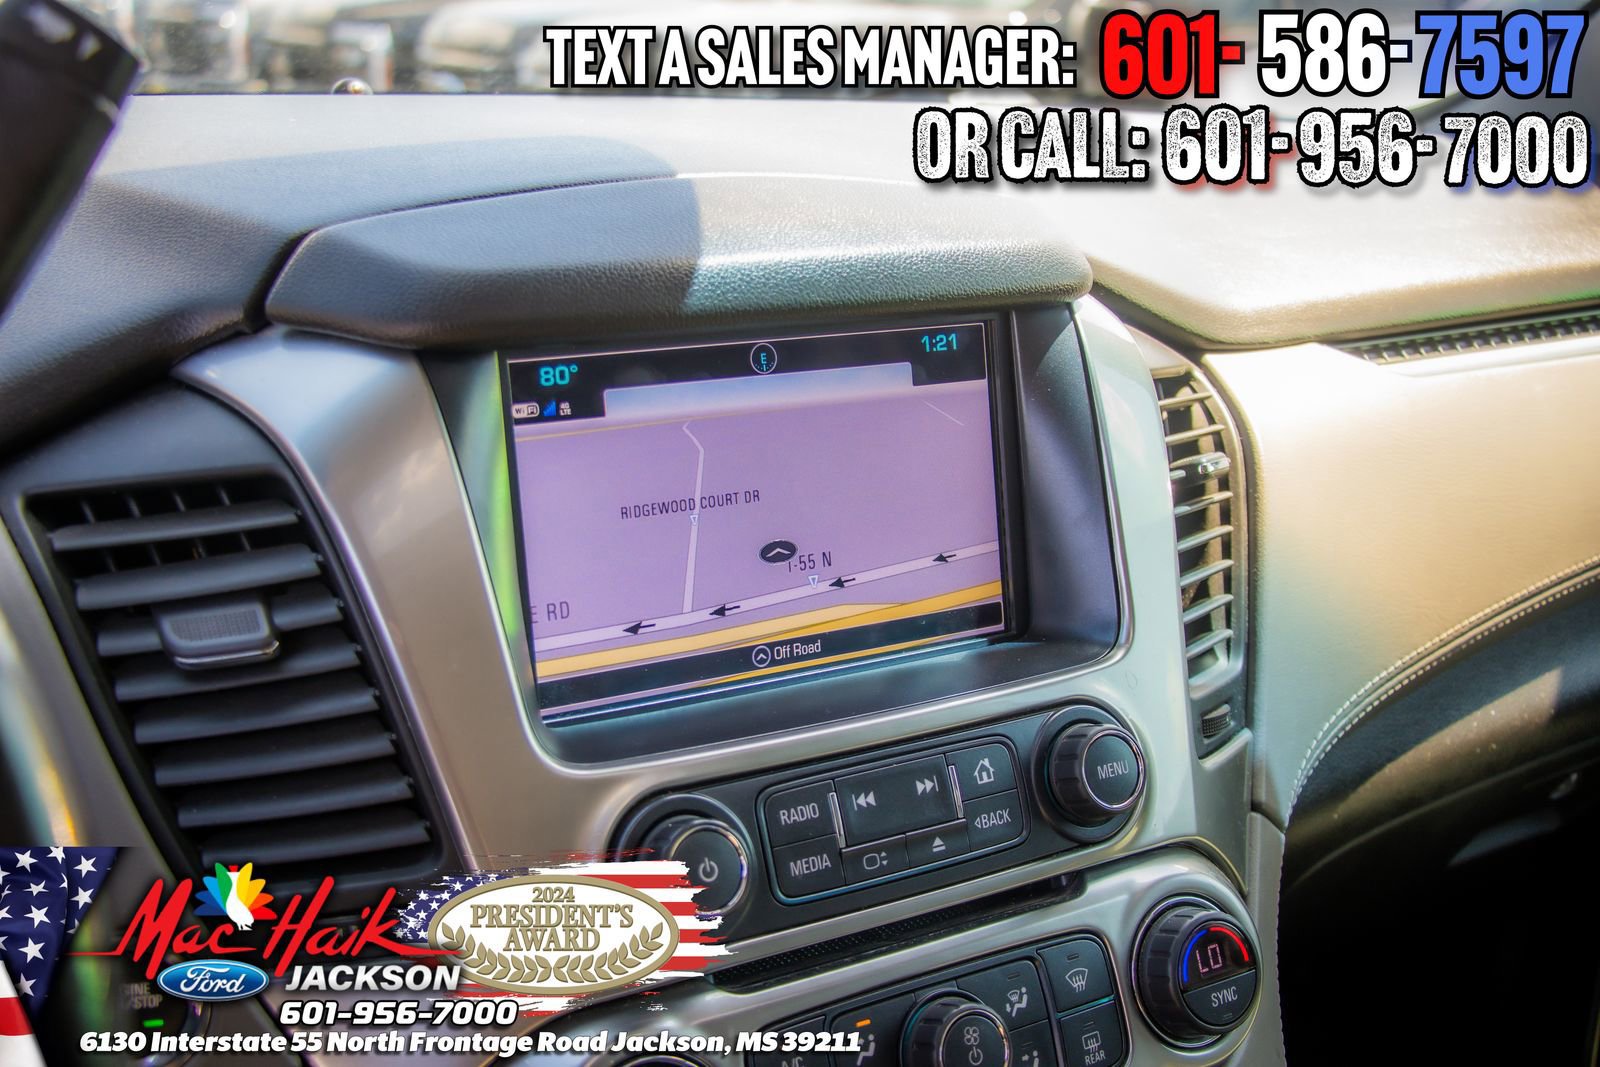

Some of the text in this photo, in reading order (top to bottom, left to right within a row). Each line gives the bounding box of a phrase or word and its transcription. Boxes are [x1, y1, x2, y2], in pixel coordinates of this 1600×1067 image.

[920, 333, 957, 353] 1:21
[539, 364, 578, 386] 80°
[620, 489, 760, 519] RIDGEWOOD COURT DR
[788, 550, 832, 573] I-55 N
[546, 601, 570, 621] RD
[774, 639, 821, 660] Off Road
[1097, 760, 1129, 780] MENU
[779, 803, 820, 826] RADIO
[979, 808, 1012, 830] BACK
[790, 854, 832, 878] MEDIA
[1211, 986, 1238, 1008] SYNC
[1084, 1050, 1106, 1065] REAR
